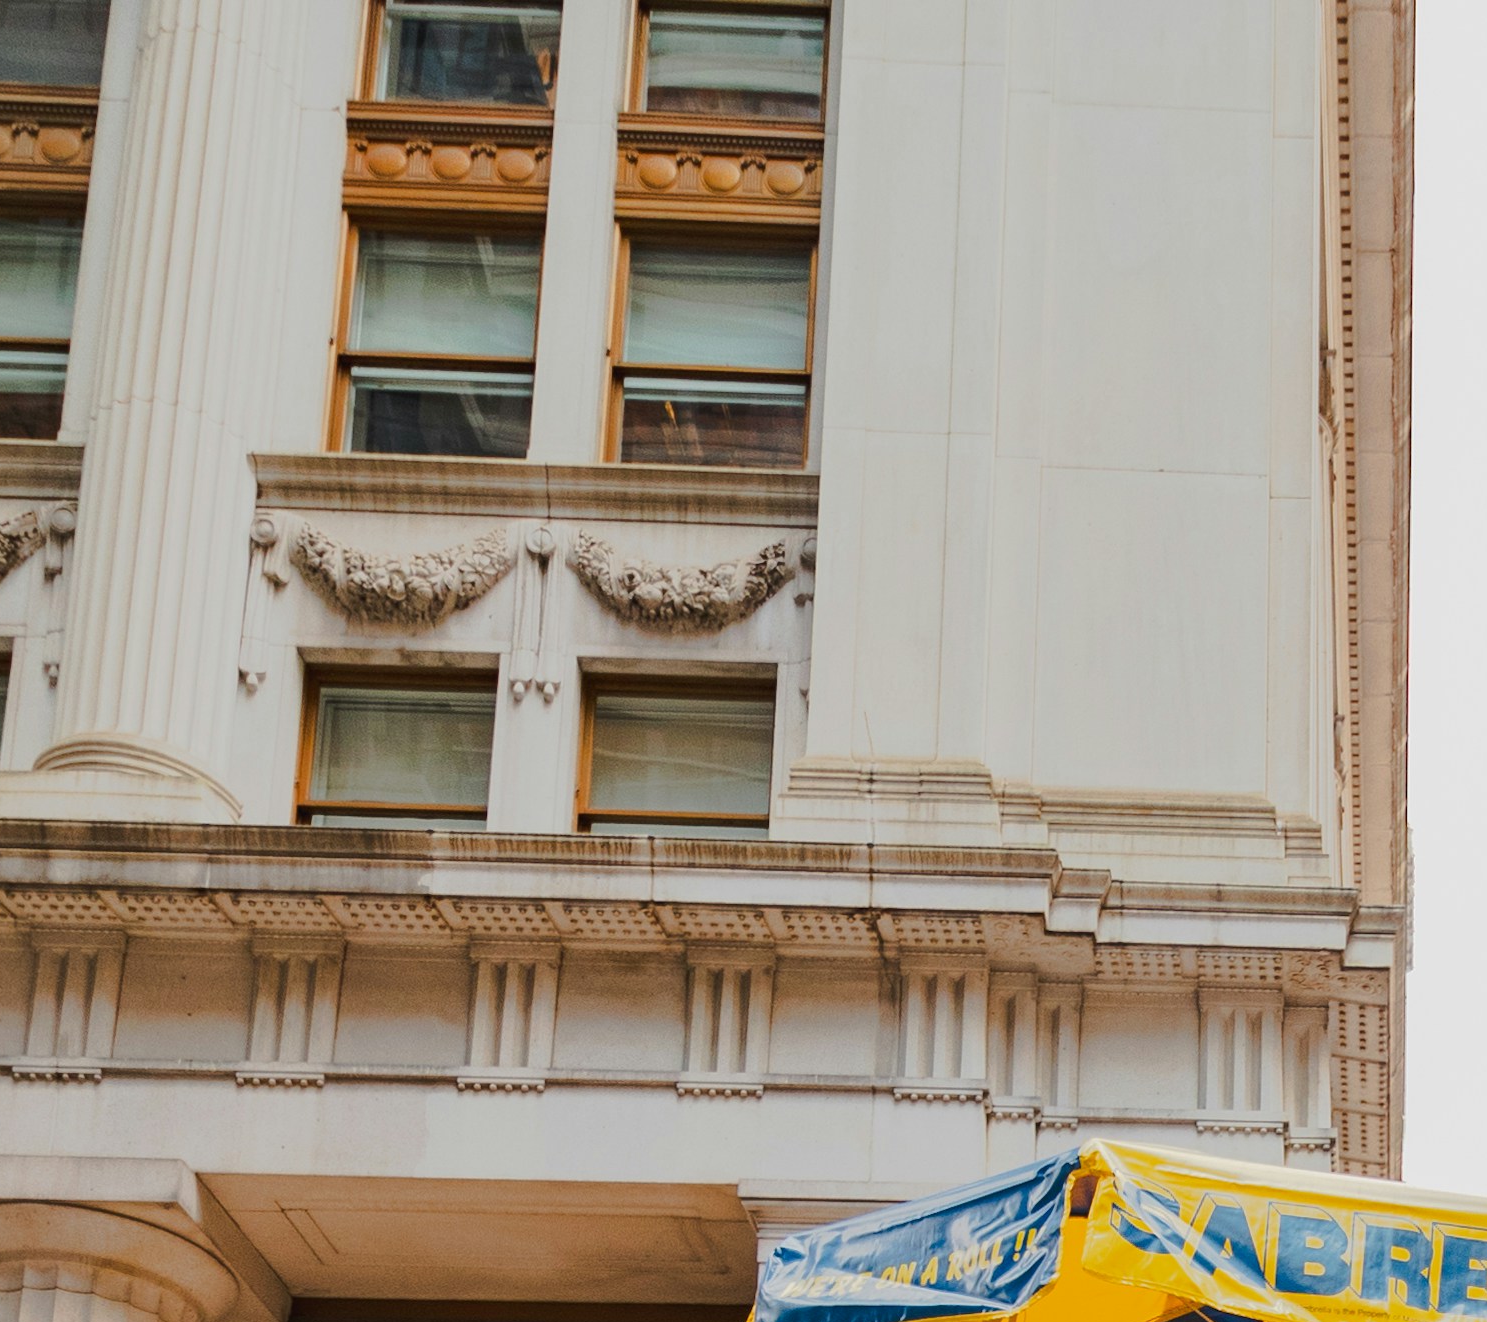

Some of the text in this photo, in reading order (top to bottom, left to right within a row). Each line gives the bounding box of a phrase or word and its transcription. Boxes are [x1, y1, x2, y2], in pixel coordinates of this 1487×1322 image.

[875, 1261, 915, 1287] ON
[920, 1263, 939, 1286] A
[945, 1240, 1004, 1281] ROLL
